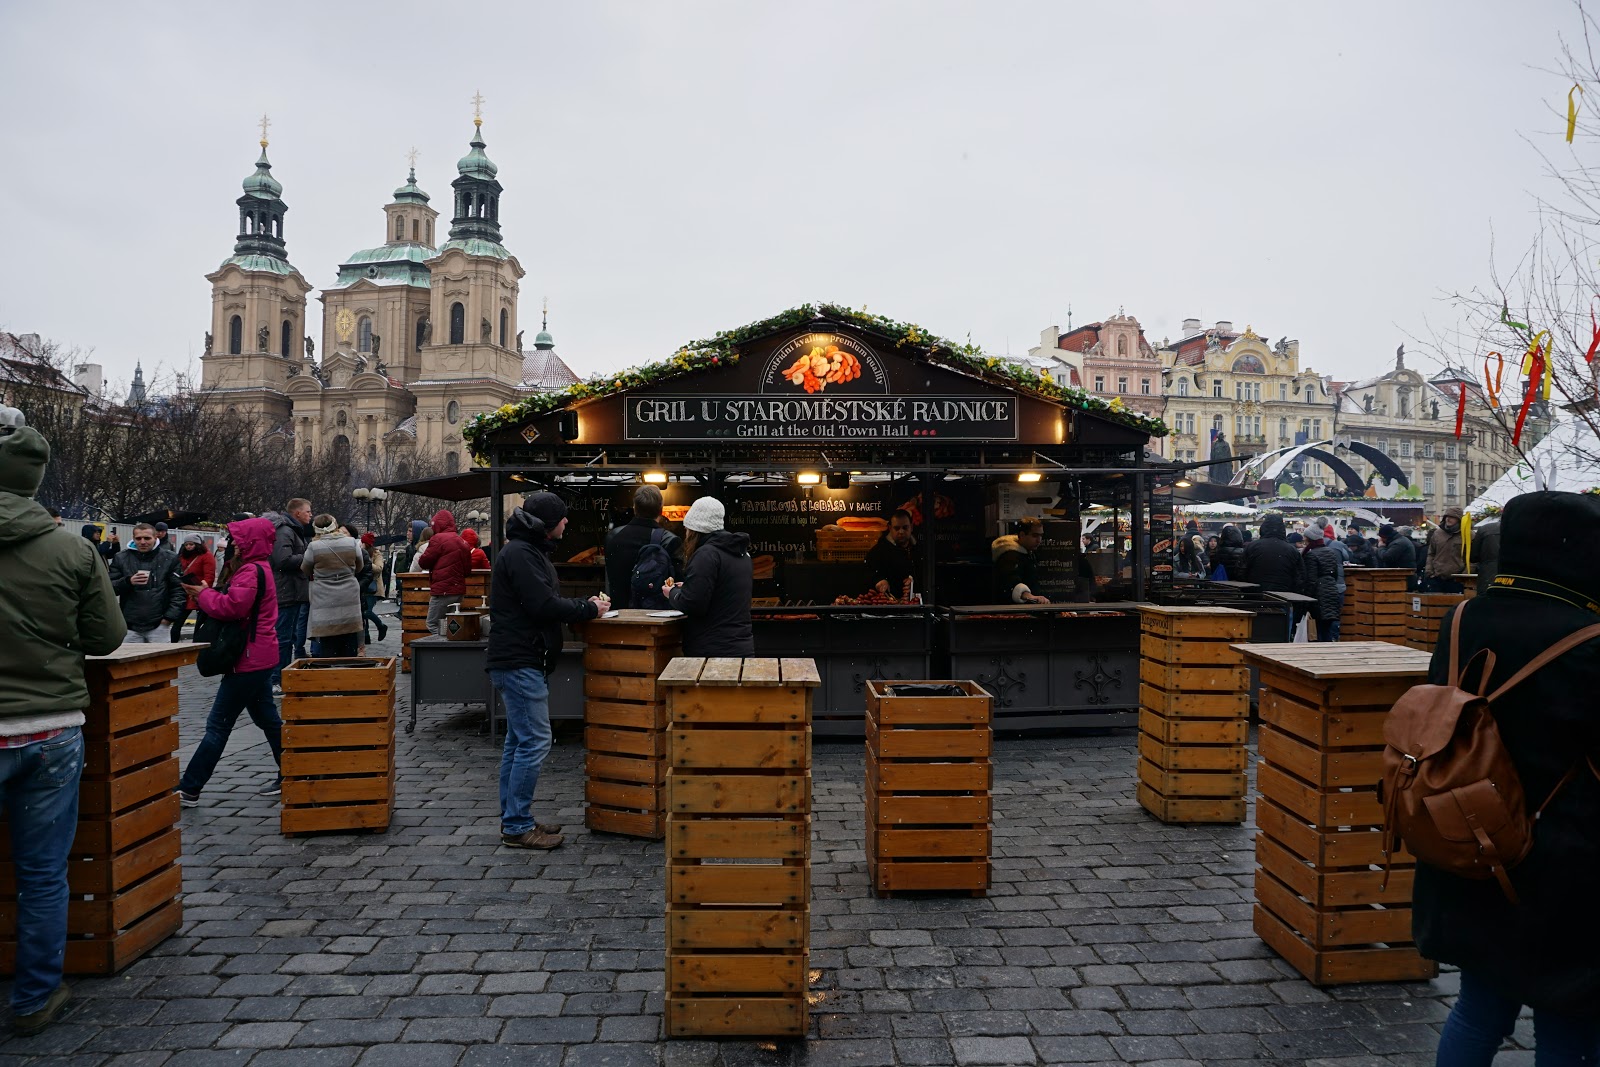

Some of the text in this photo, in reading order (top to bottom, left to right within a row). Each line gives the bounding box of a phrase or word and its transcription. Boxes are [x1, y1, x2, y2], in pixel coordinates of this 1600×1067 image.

[830, 335, 868, 357] premium
[866, 356, 884, 385] quality
[635, 397, 1009, 423] GRIL U STAROMĚSTSKÉ RADNICE
[736, 424, 909, 437] Grill at the Old Town Hall
[741, 497, 798, 512] PAPRIKOVÁ
[856, 501, 882, 512] BAGETĚ
